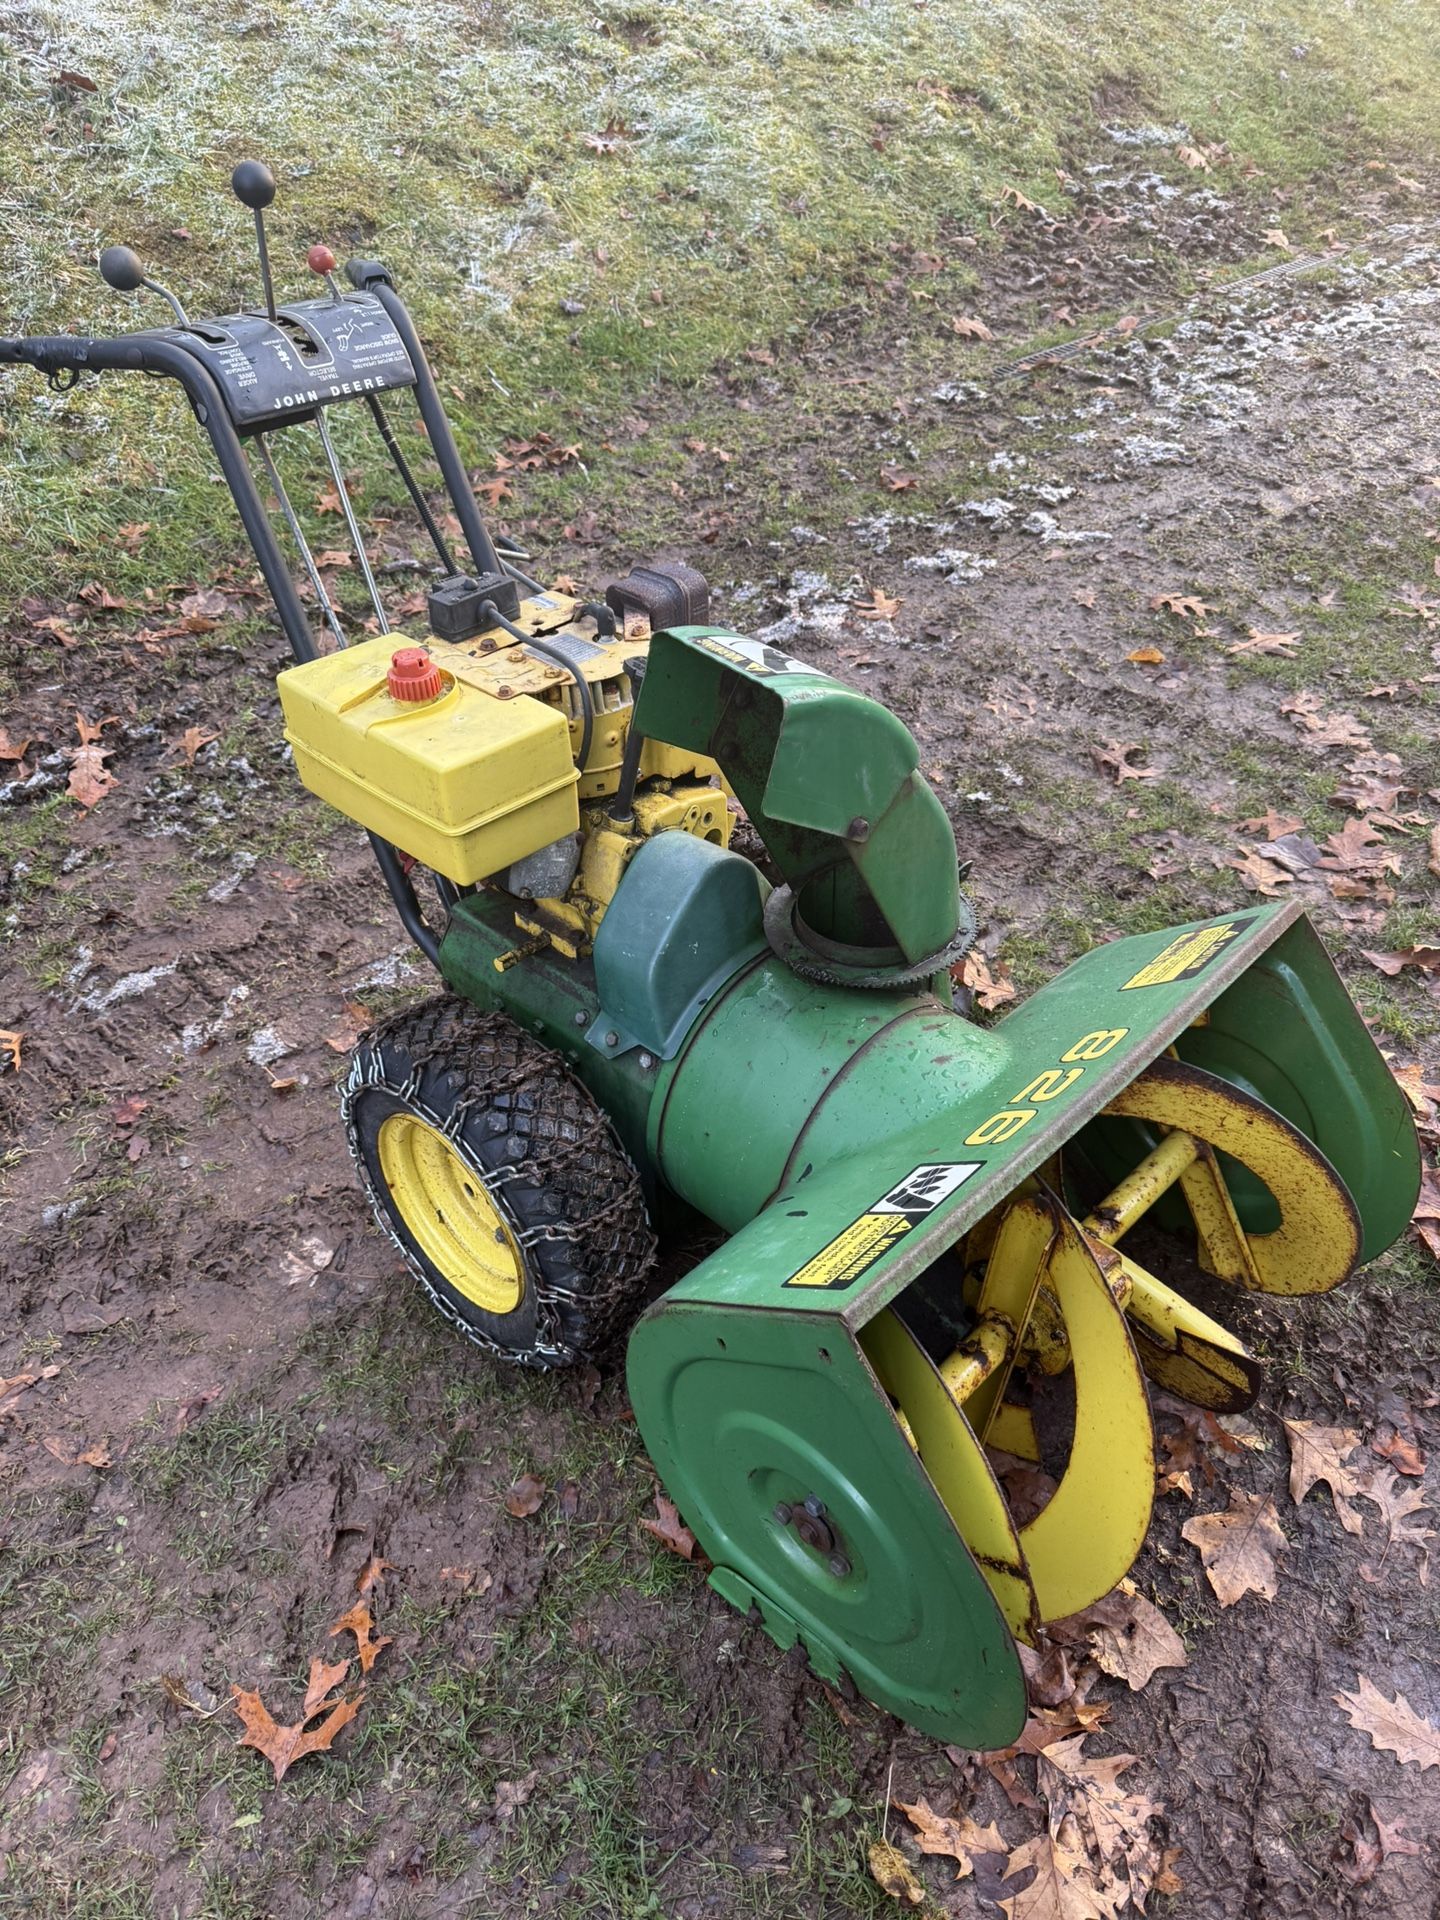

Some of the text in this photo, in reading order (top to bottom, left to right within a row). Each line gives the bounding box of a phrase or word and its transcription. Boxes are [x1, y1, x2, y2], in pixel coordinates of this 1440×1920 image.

[354, 338, 399, 352] SNOW DISCHARGE
[238, 378, 258, 387] AUGER
[307, 366, 337, 377] SELECTOR
[319, 372, 340, 381] TRAVEL
[274, 376, 385, 409] JOHN DEERE
[963, 1027, 1130, 1146] 826
[852, 1215, 894, 1249] ROTATING
[823, 1215, 900, 1283] AVOID INJURY FROM
[838, 1237, 897, 1280] WARNING
